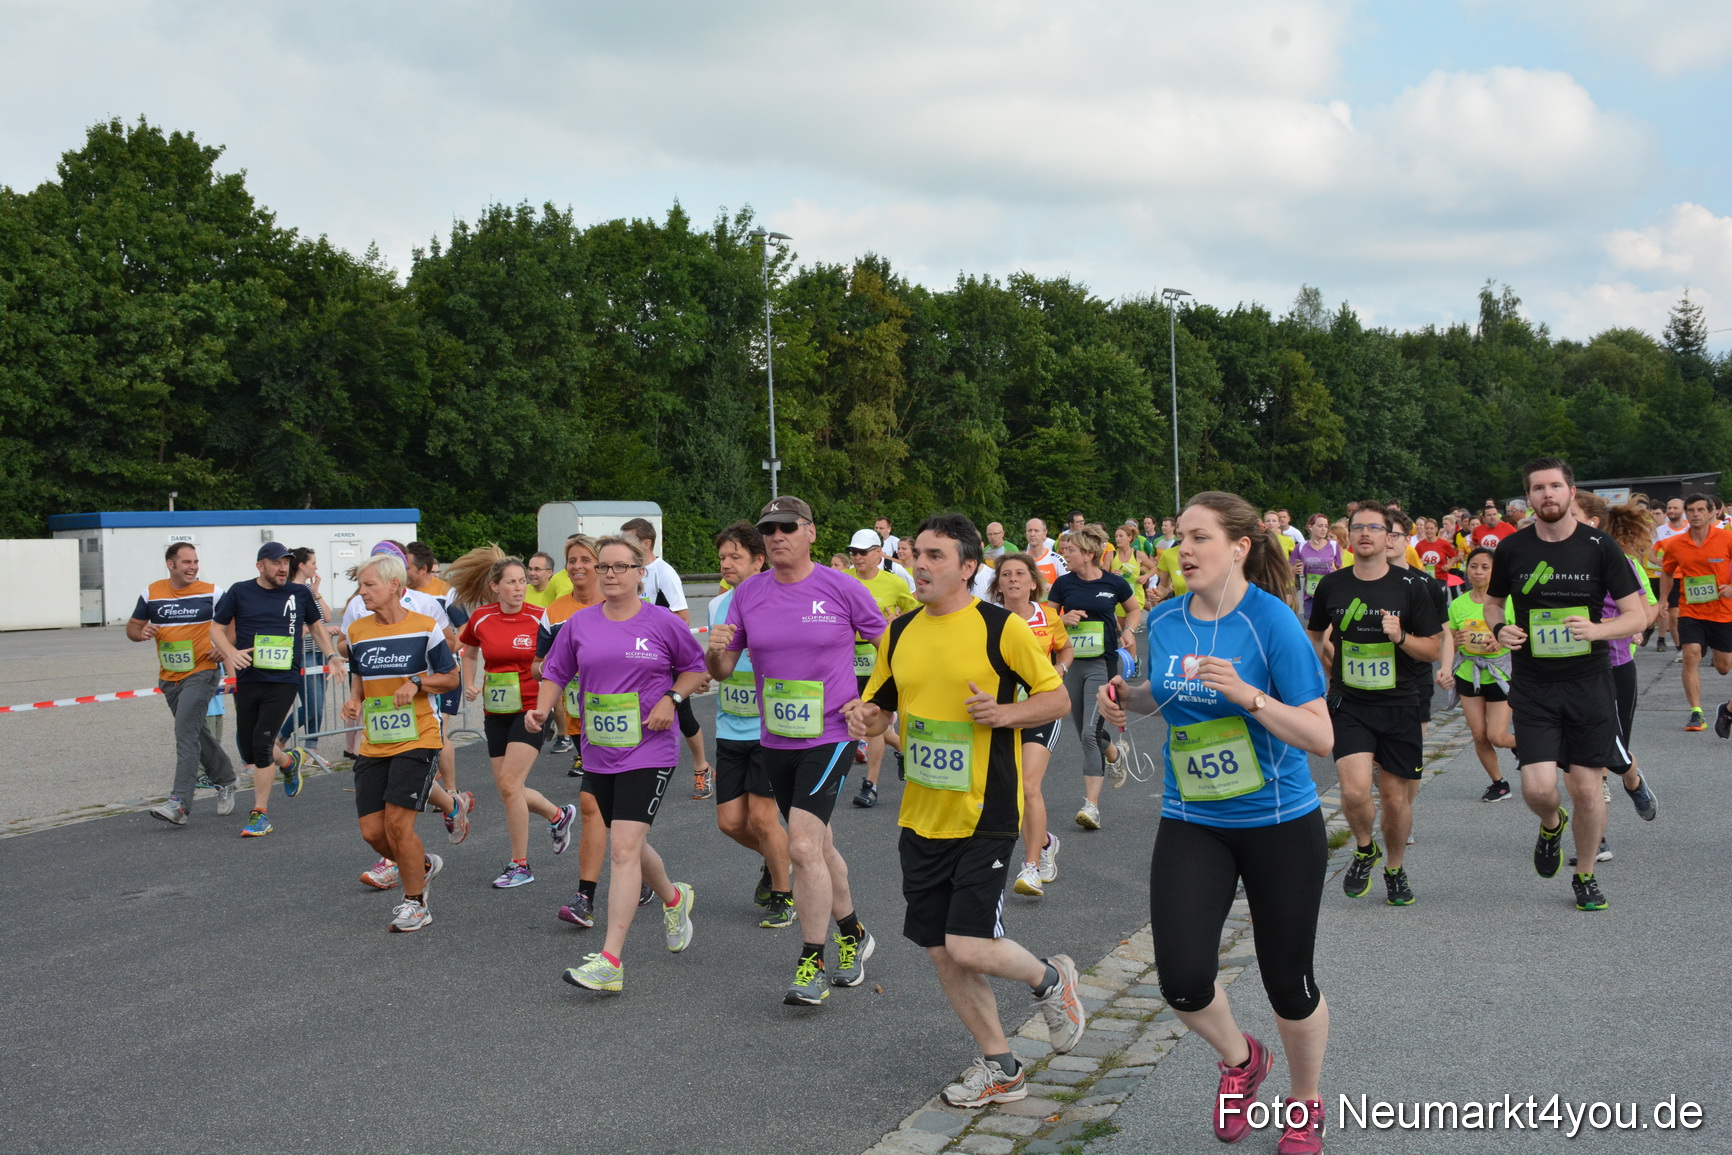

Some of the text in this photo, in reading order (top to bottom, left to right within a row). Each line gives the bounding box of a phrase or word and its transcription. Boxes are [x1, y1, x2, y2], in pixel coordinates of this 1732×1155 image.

[1482, 540, 1498, 548] 48
[1423, 554, 1438, 564] 48
[1688, 585, 1715, 596] 1033
[164, 605, 200, 616] Fischer
[812, 600, 827, 614] K
[1072, 635, 1094, 648] 771
[1470, 633, 1487, 645] 22
[1537, 628, 1582, 644] 111
[635, 637, 649, 651] K
[162, 652, 191, 664] 1635
[258, 648, 289, 660] 1157
[367, 653, 412, 665] Fischer
[1164, 655, 1179, 677] I
[1347, 660, 1390, 677] 1118
[490, 689, 506, 702] 27
[723, 686, 757, 704] 1497
[774, 702, 810, 722] 664
[371, 712, 411, 731] 1629
[593, 715, 629, 733] 665
[910, 743, 964, 772] 1288
[1187, 749, 1239, 779] 458
